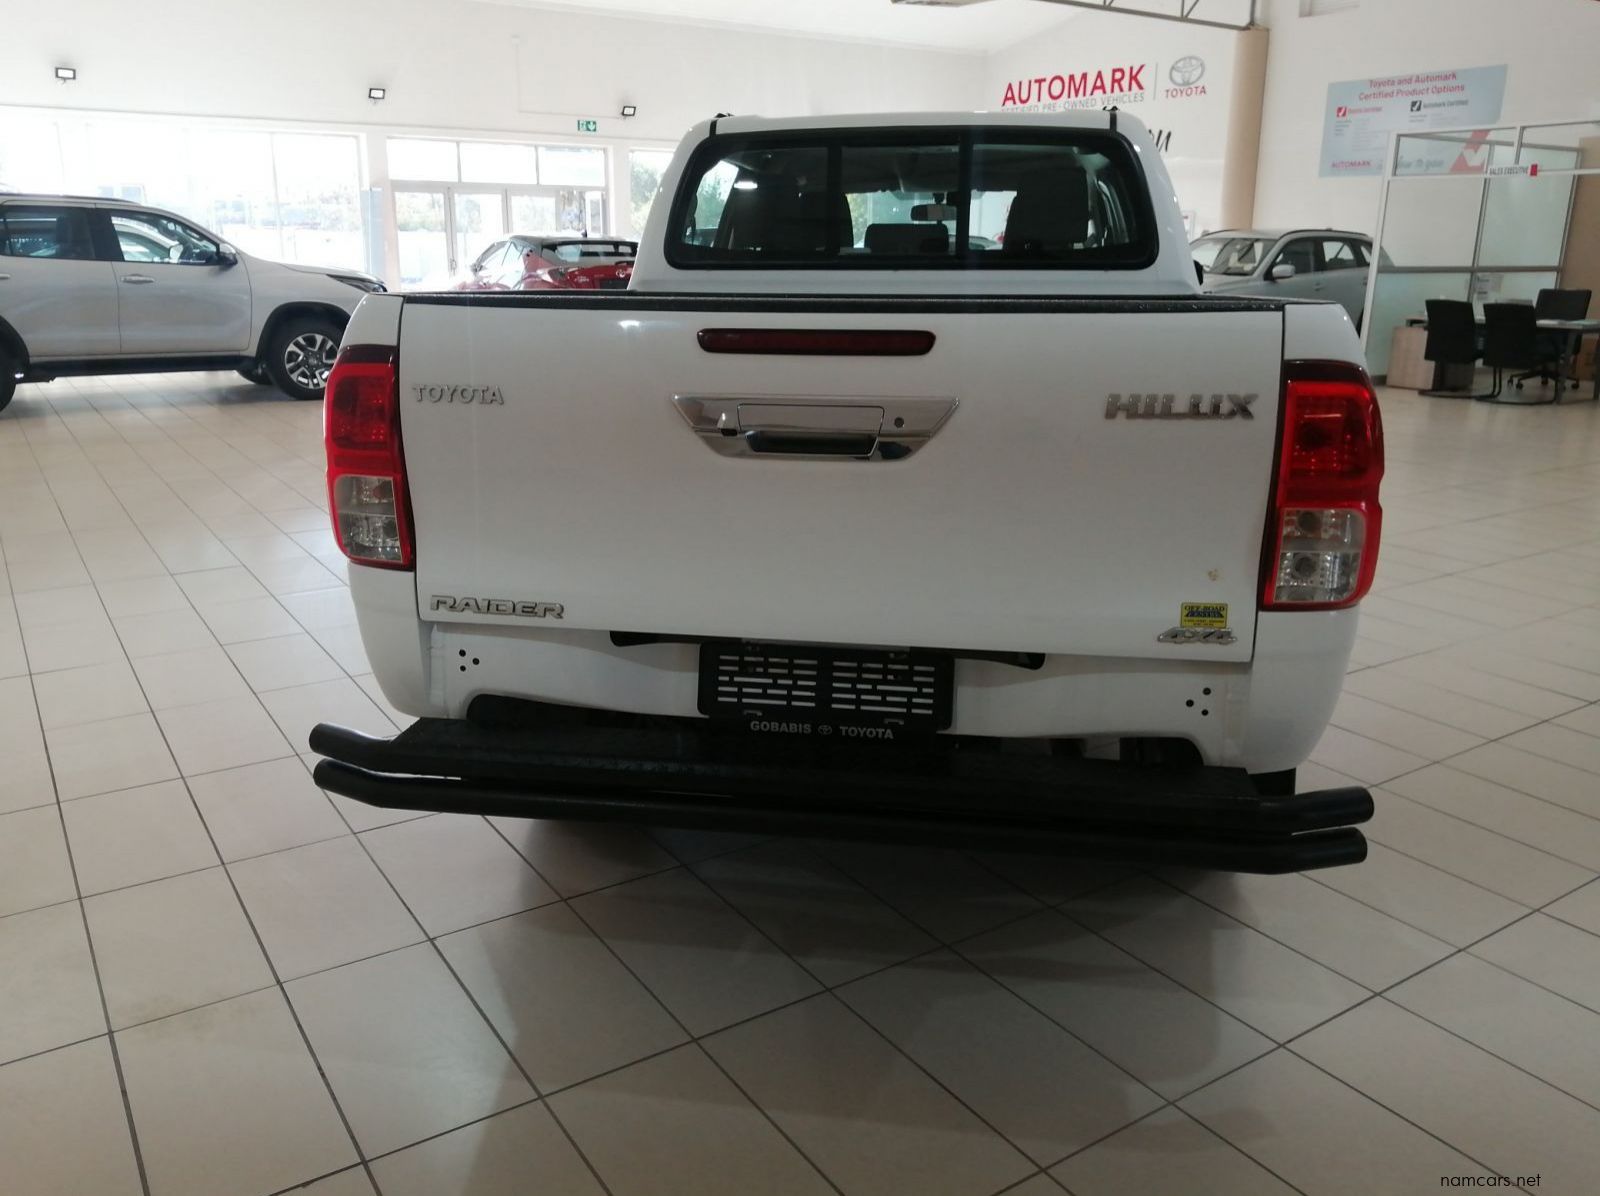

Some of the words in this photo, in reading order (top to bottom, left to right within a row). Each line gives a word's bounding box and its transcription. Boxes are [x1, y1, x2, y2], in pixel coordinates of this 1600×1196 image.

[1001, 64, 1146, 107] AUTOMARK
[1368, 78, 1396, 89] Toyota
[1397, 76, 1413, 86] and
[1414, 72, 1457, 84] Automark
[1100, 92, 1145, 106] VEHICLES
[1164, 85, 1207, 99] TOYOTA
[1358, 90, 1395, 101] Certified
[1396, 87, 1430, 98] Product
[1431, 84, 1465, 95] Options
[1331, 159, 1371, 169] AUTOMARK
[412, 384, 505, 405] TOYOTA
[1104, 393, 1259, 420] HILUX
[430, 594, 564, 619] RAIDER
[750, 720, 812, 735] GOBABIS
[840, 726, 895, 740] TOYOTA
